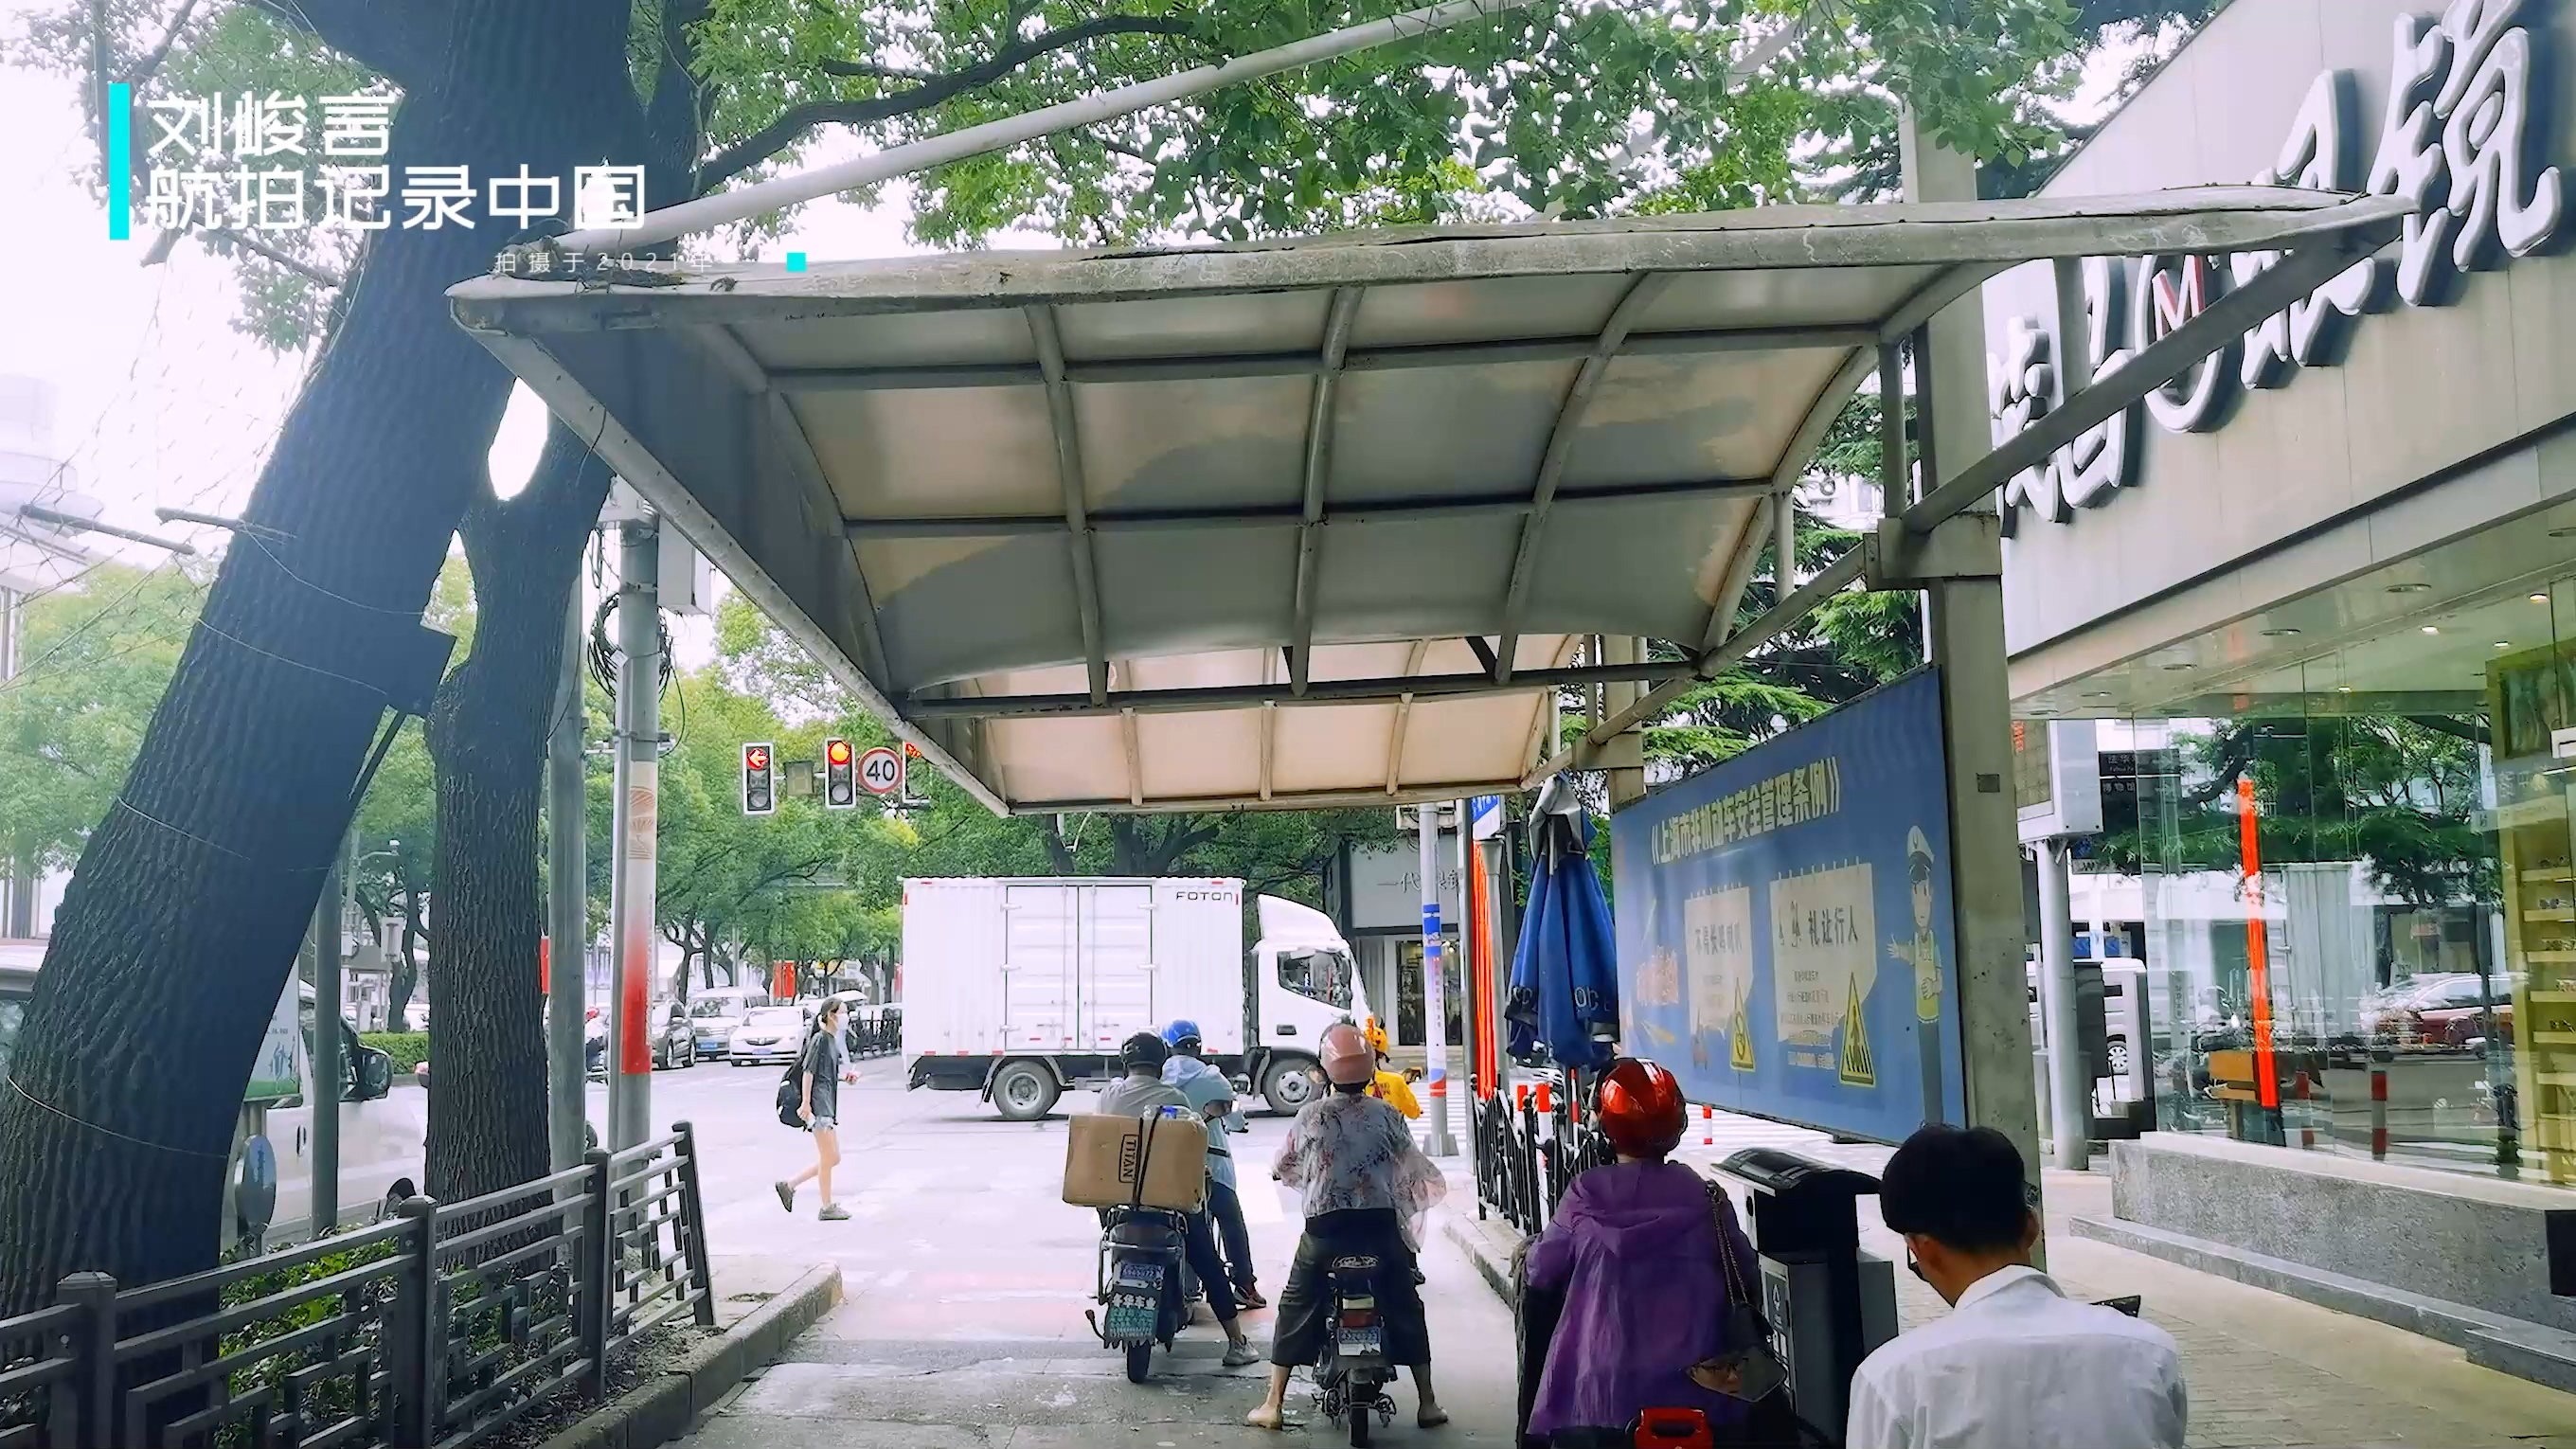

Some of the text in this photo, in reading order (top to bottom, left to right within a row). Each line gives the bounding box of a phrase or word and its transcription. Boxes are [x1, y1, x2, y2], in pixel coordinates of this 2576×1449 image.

[866, 760, 896, 781] 40
[1175, 891, 1233, 902] FOTON
[1122, 1139, 1136, 1177] TITAN
